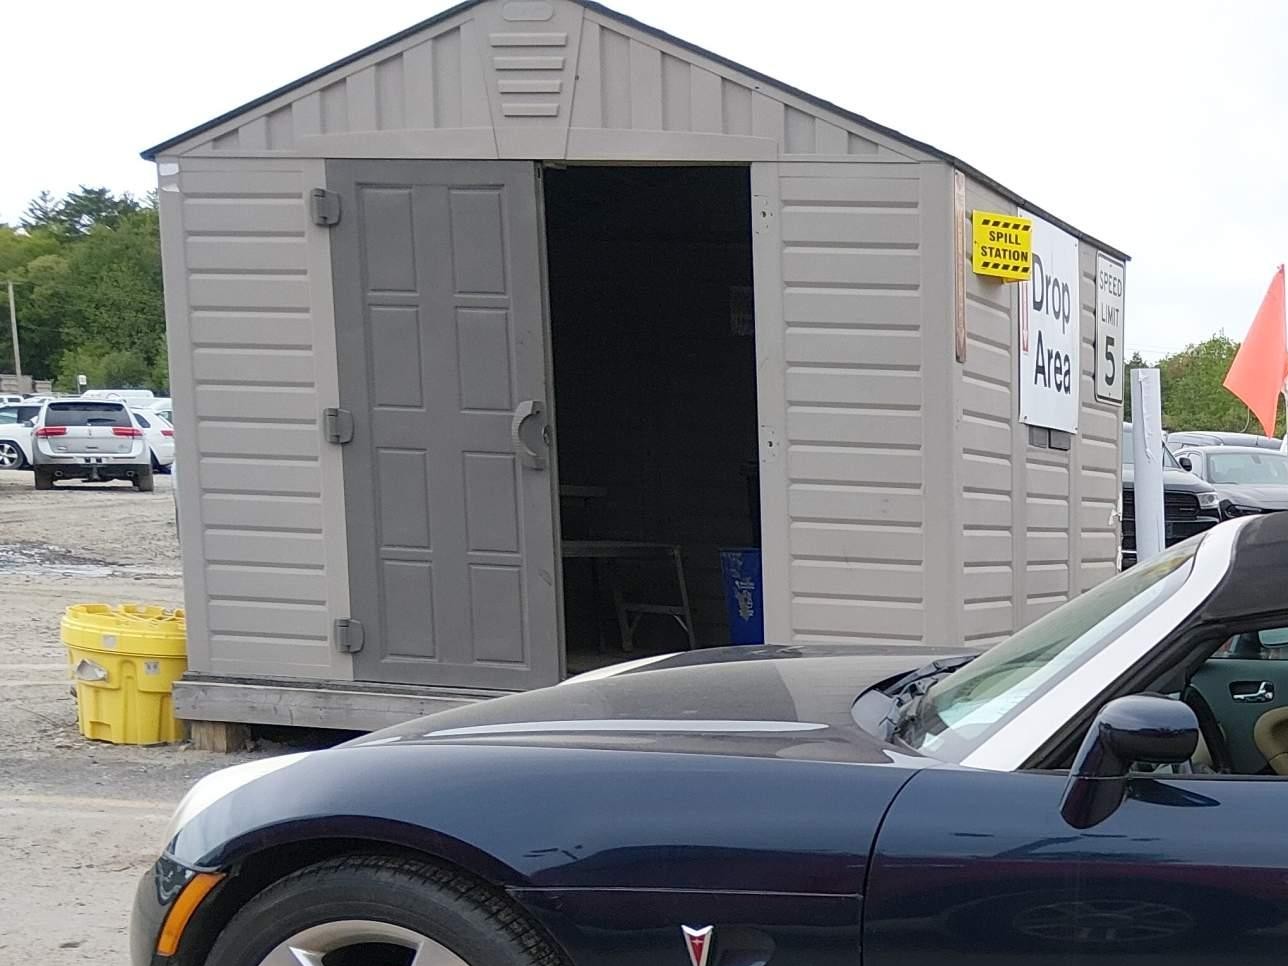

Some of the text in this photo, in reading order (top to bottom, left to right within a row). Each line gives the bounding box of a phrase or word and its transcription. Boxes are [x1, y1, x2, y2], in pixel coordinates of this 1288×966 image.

[988, 230, 1022, 246] SPILL
[980, 245, 1029, 263] STATION
[1032, 253, 1071, 334] Drop
[1099, 270, 1122, 297] SPEED
[1101, 308, 1120, 328] LIMIT
[1034, 330, 1071, 394] Area
[1104, 336, 1116, 386] 5
